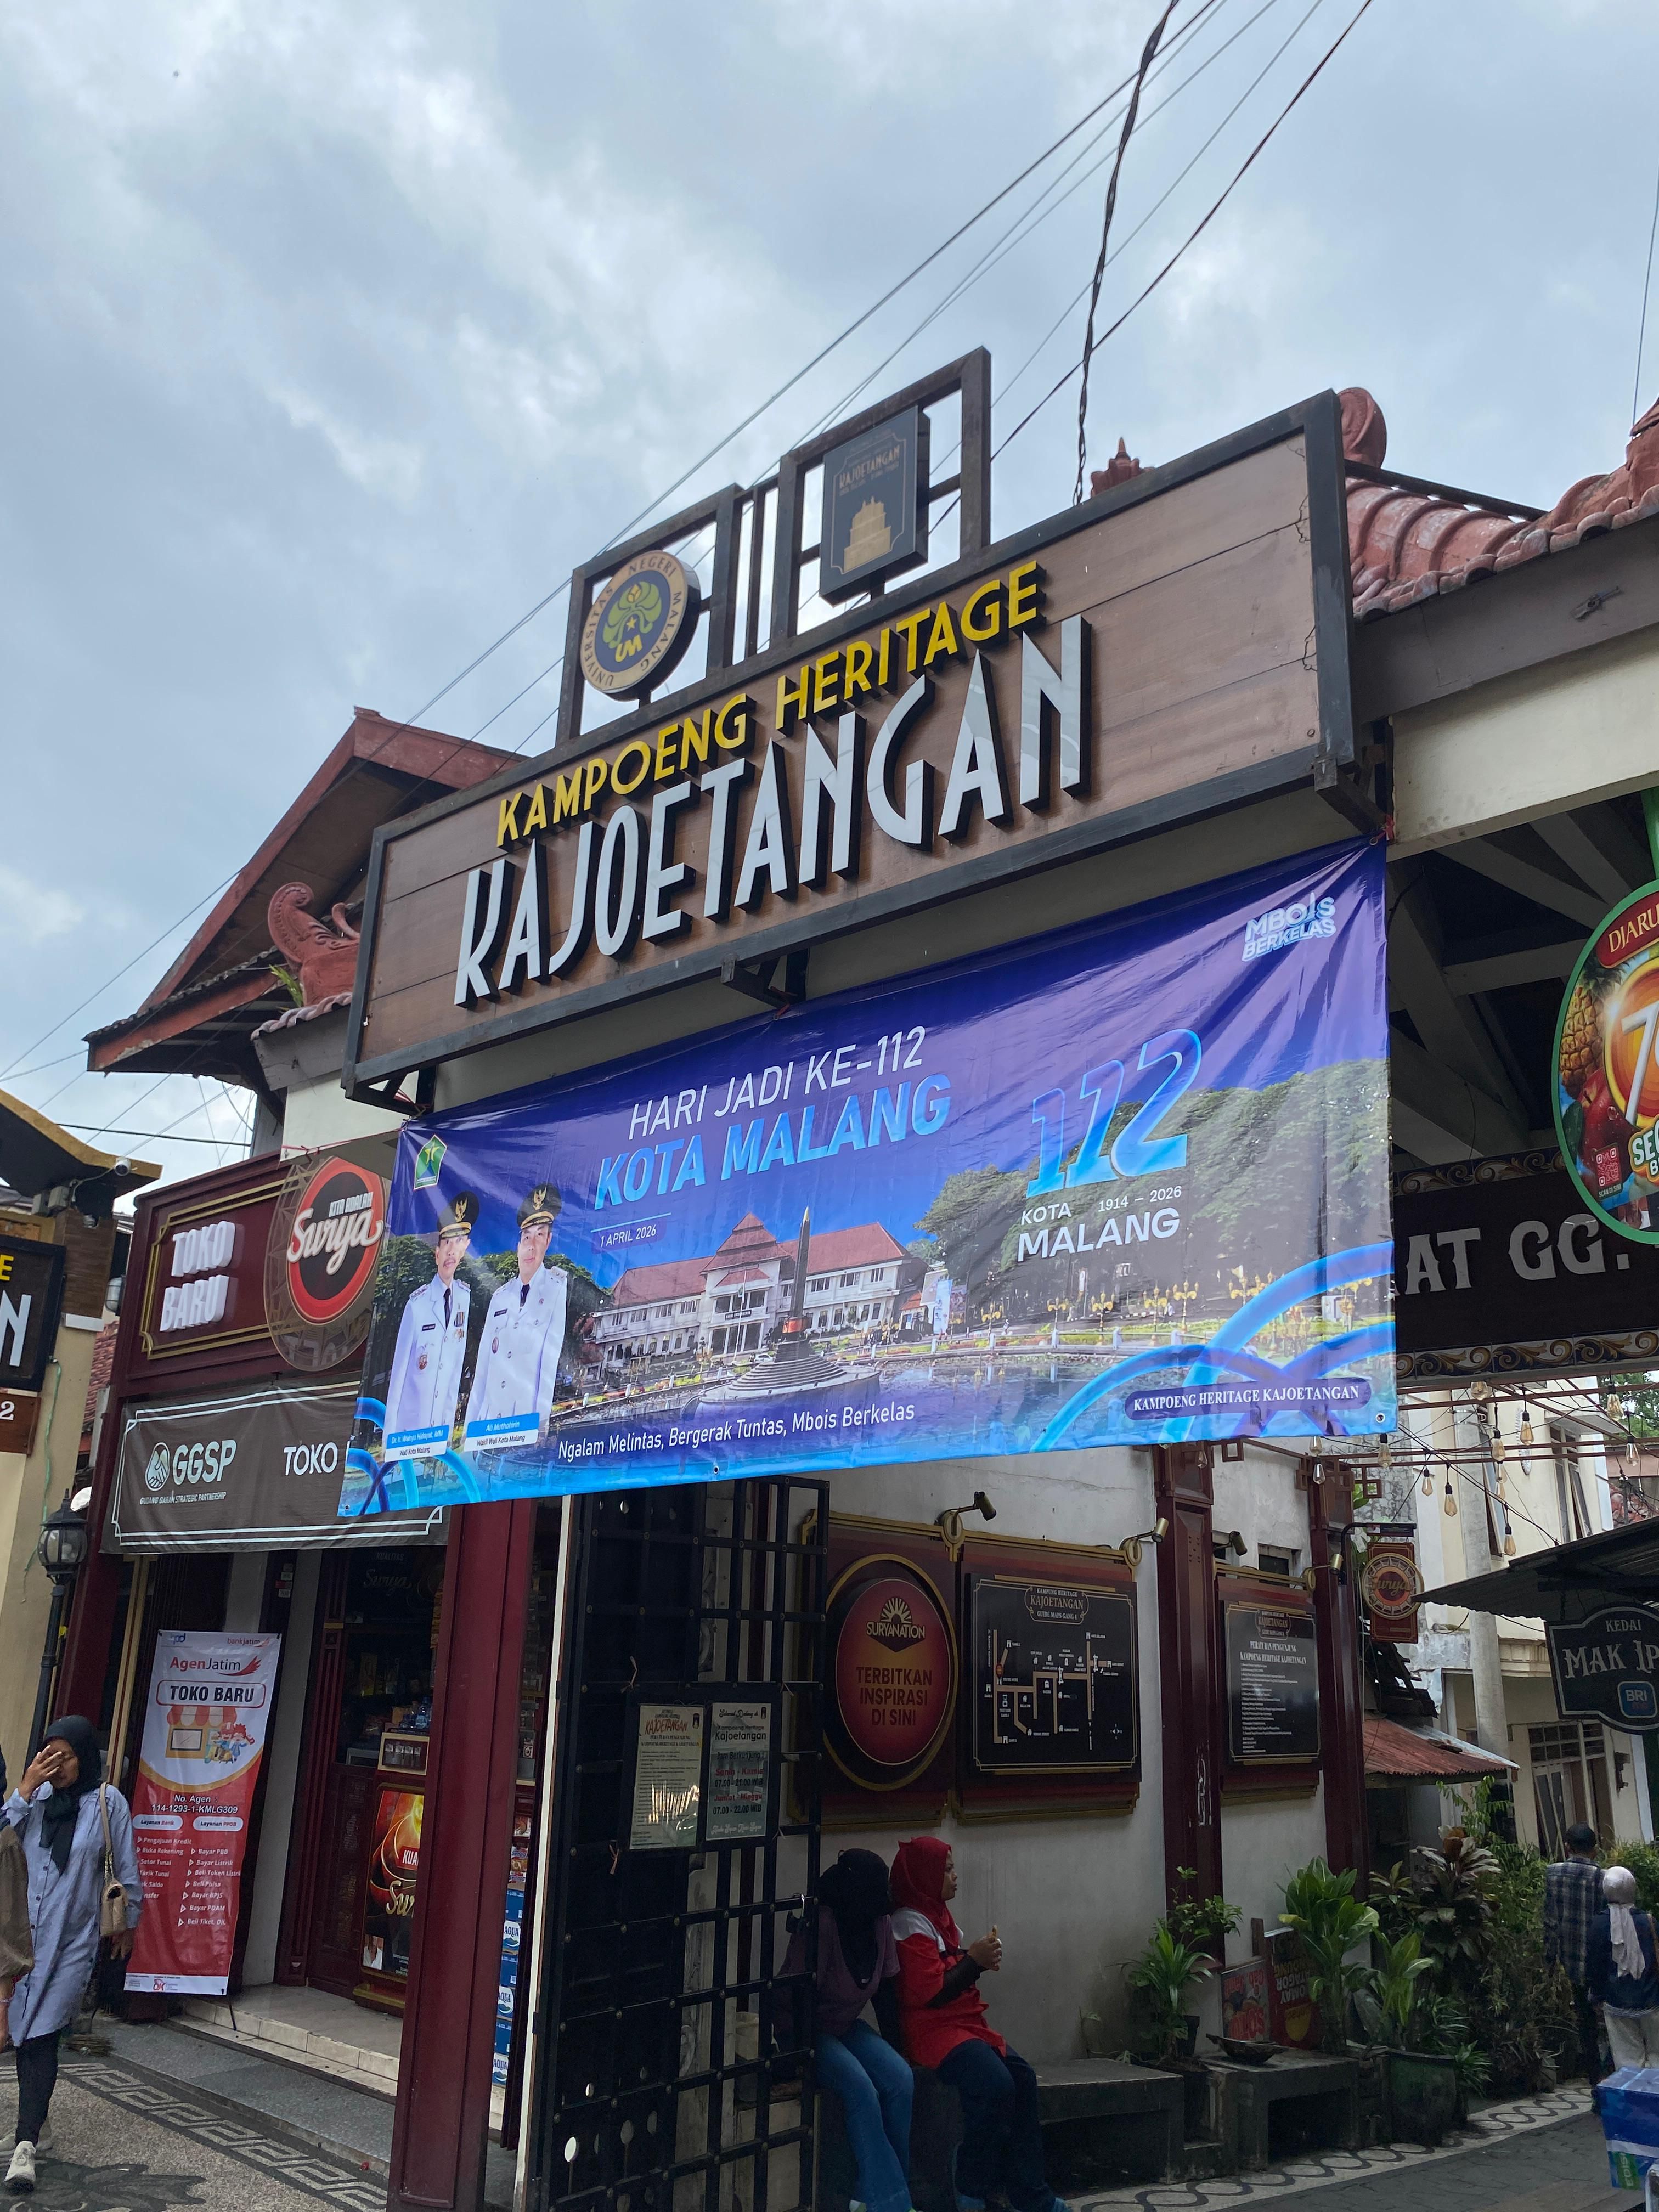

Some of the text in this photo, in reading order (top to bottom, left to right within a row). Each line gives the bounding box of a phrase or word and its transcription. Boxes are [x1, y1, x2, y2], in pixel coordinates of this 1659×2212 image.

[629, 556, 676, 576] NEGERI
[584, 586, 614, 686] UNIVERSITAS
[640, 590, 682, 672] MALANG
[496, 560, 1042, 848] KAMPOENG HERITAGE
[454, 614, 1086, 1006] KAJOETANGAN
[1244, 891, 1336, 943] MBOIS
[1241, 918, 1336, 962] BERKELAS
[1621, 1000, 1659, 1127] 7
[628, 1025, 926, 1141] HARI JADI KE-112
[1026, 1028, 1203, 1198] 112
[594, 1073, 952, 1210] KOTA MALANG
[1098, 1186, 1182, 1213] 1914 2026
[1598, 1189, 1609, 1198] SCAN
[1020, 1201, 1071, 1226] KOTA
[287, 1207, 384, 1276] Surya
[600, 1224, 657, 1248] 1 APRIL 2026
[1017, 1207, 1181, 1262] MALANG
[171, 1221, 235, 1277] TOKO
[1395, 1227, 1480, 1296] AT
[160, 1274, 229, 1332] BARU
[1133, 1385, 1359, 1412] KAMPOENG HERITAGE KAJOETANGAN
[477, 1438, 488, 1446] Wakil
[498, 1436, 509, 1444] Kota
[509, 1434, 526, 1443] Malang
[558, 1401, 916, 1463] Ngalam Melintas, Bergerak Tuntas, Mbois Berkelas
[417, 1446, 431, 1454] Malang
[172, 1439, 338, 1485] GGSP TOKO
[140, 1491, 227, 1505] GUDANG GARAM STRATEGIC PARTNERSHIP
[1036, 1587, 1078, 1598] KAMPUNG HERITAGE
[1030, 1594, 1084, 1611] KAJOETANGAN
[866, 1622, 926, 1640] SURYANATION
[1258, 1616, 1289, 1628] KAJOETANGAN
[1605, 1619, 1641, 1632] KEDAI
[228, 1637, 261, 1646] bankjatim
[170, 1656, 241, 1672] AgenJatim
[1562, 1643, 1627, 1679] MAK
[855, 1665, 933, 1688] TERBITKAN
[170, 1685, 254, 1703] TOKO BARU
[859, 1688, 928, 1707] INSPIRASI
[1626, 1689, 1647, 1701] BRI
[871, 1708, 917, 1726] DI SINI
[715, 1730, 766, 1742] Kajoetangan
[715, 1768, 735, 1776] Senin
[714, 1779, 730, 1787] 07.00
[752, 1778, 763, 1786] WIB
[189, 1795, 211, 1804] Agen
[713, 1805, 729, 1815] 07.00
[751, 1804, 762, 1813] WIB
[143, 1837, 172, 1845] Pengajuan
[191, 1892, 209, 1900] Bayar
[504, 1925, 519, 1937] AQUA
[493, 2058, 508, 2070] AQUA
